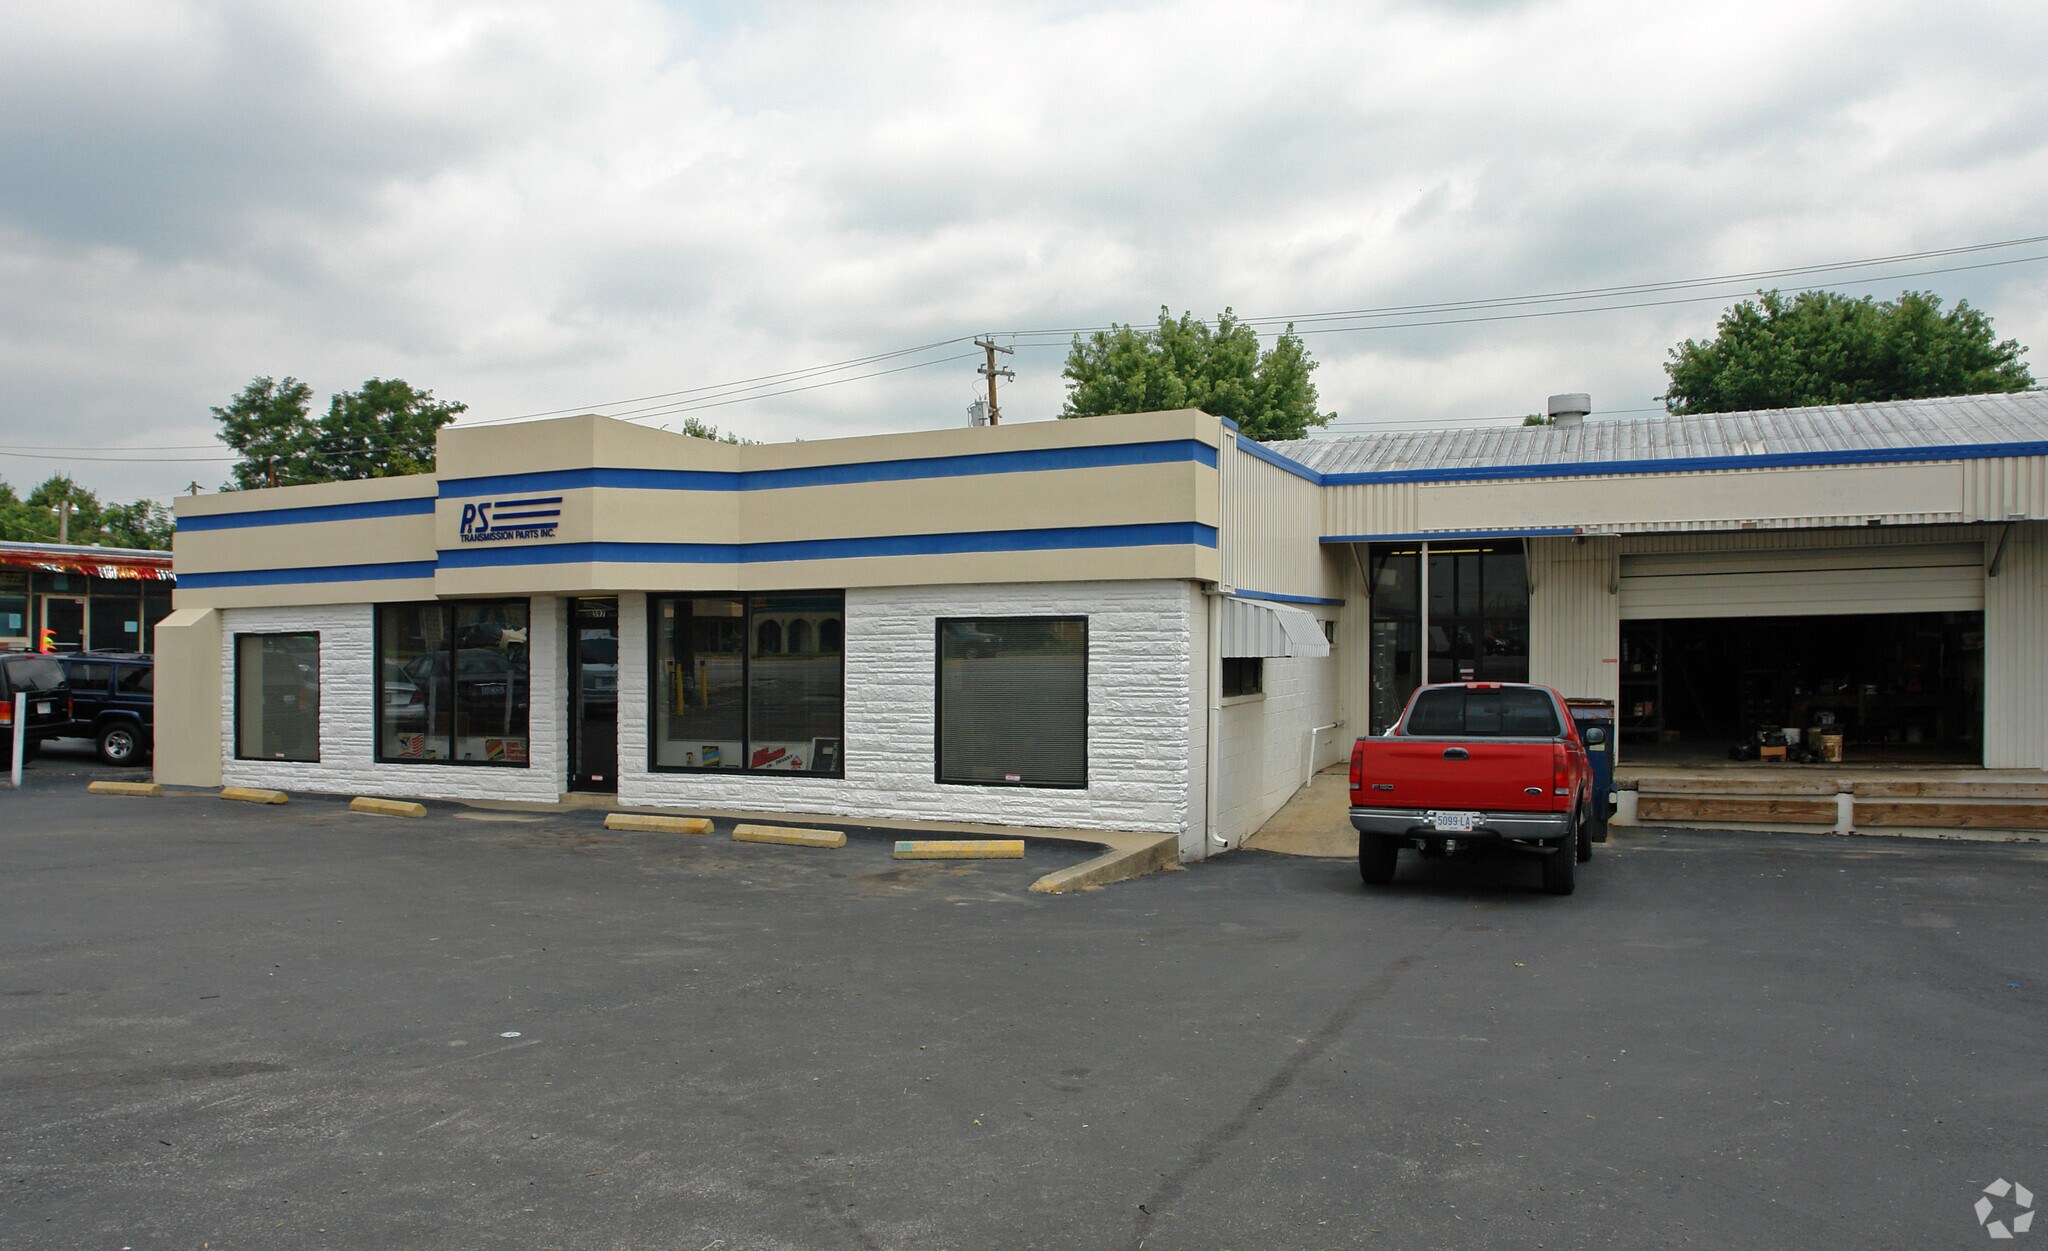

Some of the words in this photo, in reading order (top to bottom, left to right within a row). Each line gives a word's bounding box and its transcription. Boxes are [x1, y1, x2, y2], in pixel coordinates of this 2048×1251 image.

[460, 531, 514, 543] TRANSMISSION
[515, 529, 539, 540] PARTS
[540, 528, 556, 538] INC.
